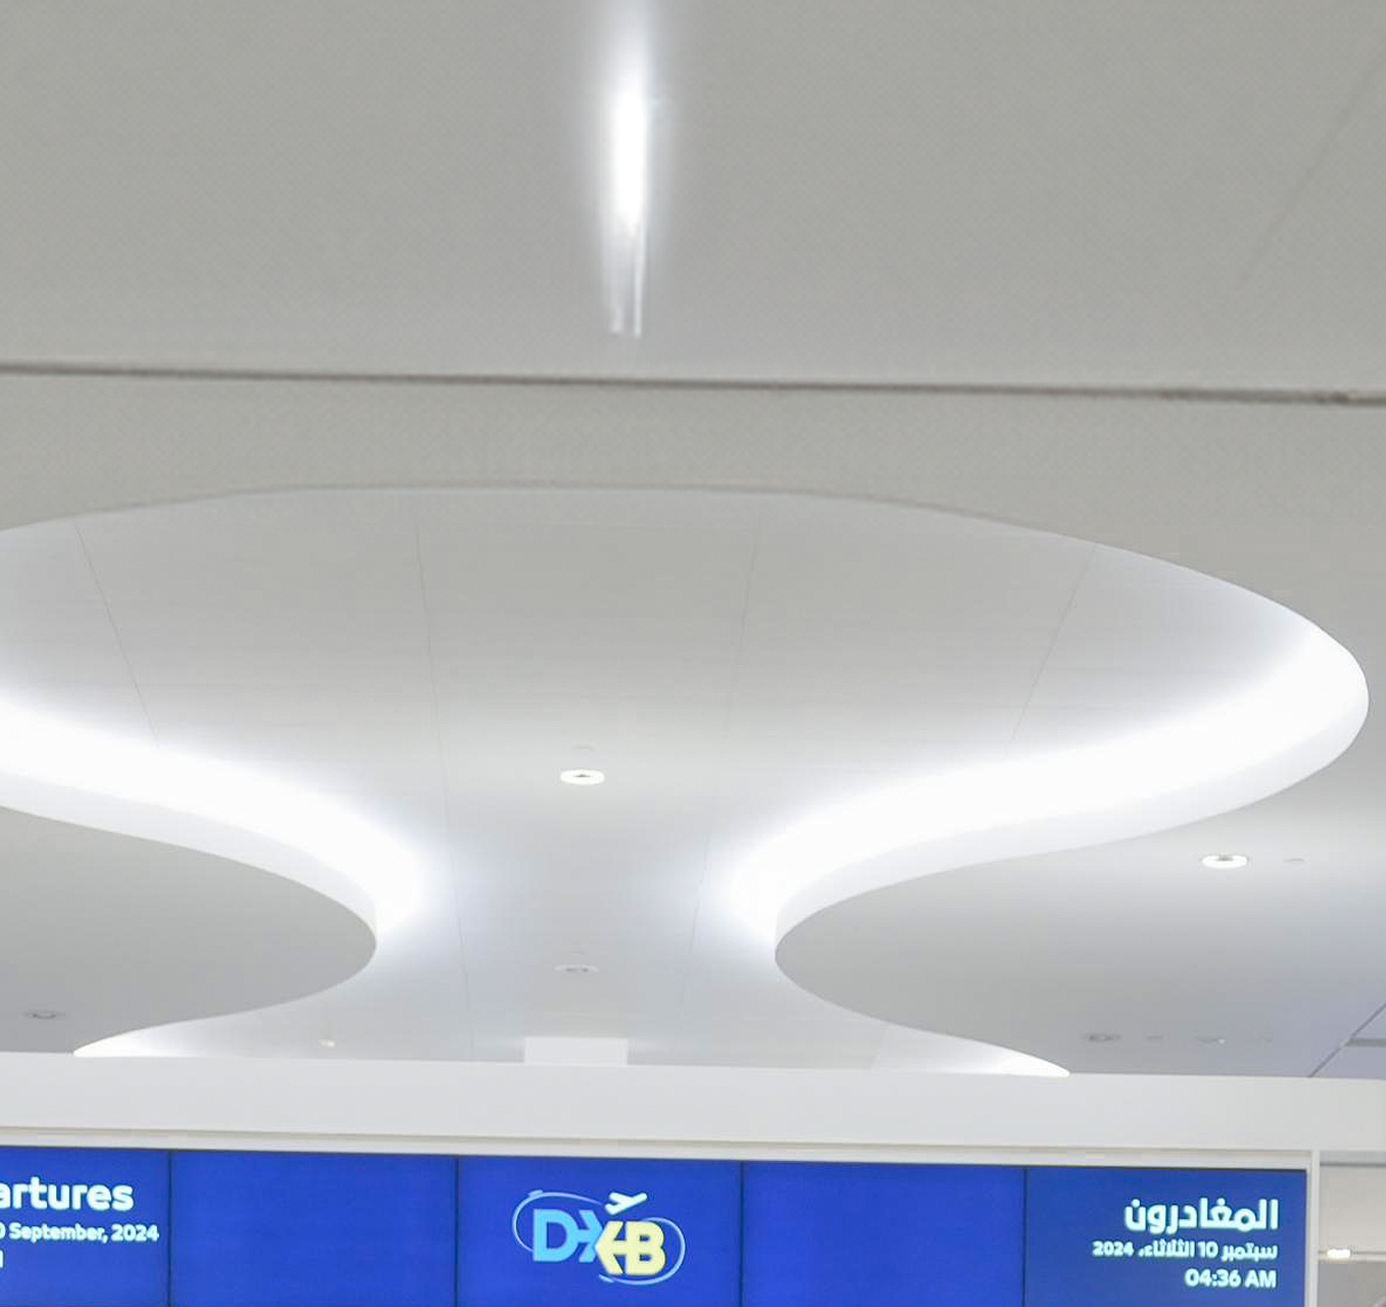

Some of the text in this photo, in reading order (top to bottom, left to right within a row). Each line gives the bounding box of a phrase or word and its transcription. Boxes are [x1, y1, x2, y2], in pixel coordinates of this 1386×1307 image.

[1124, 1198, 1278, 1234] المغادرون
[9, 1223, 108, 1243] September,
[111, 1224, 159, 1241] 2024
[533, 1209, 665, 1276] DXB
[1092, 1241, 1134, 1256] 2024
[1198, 1242, 1218, 1258] 10
[1221, 1243, 1277, 1262] سبتمبر
[1184, 1269, 1276, 1288] 04:36 AM
